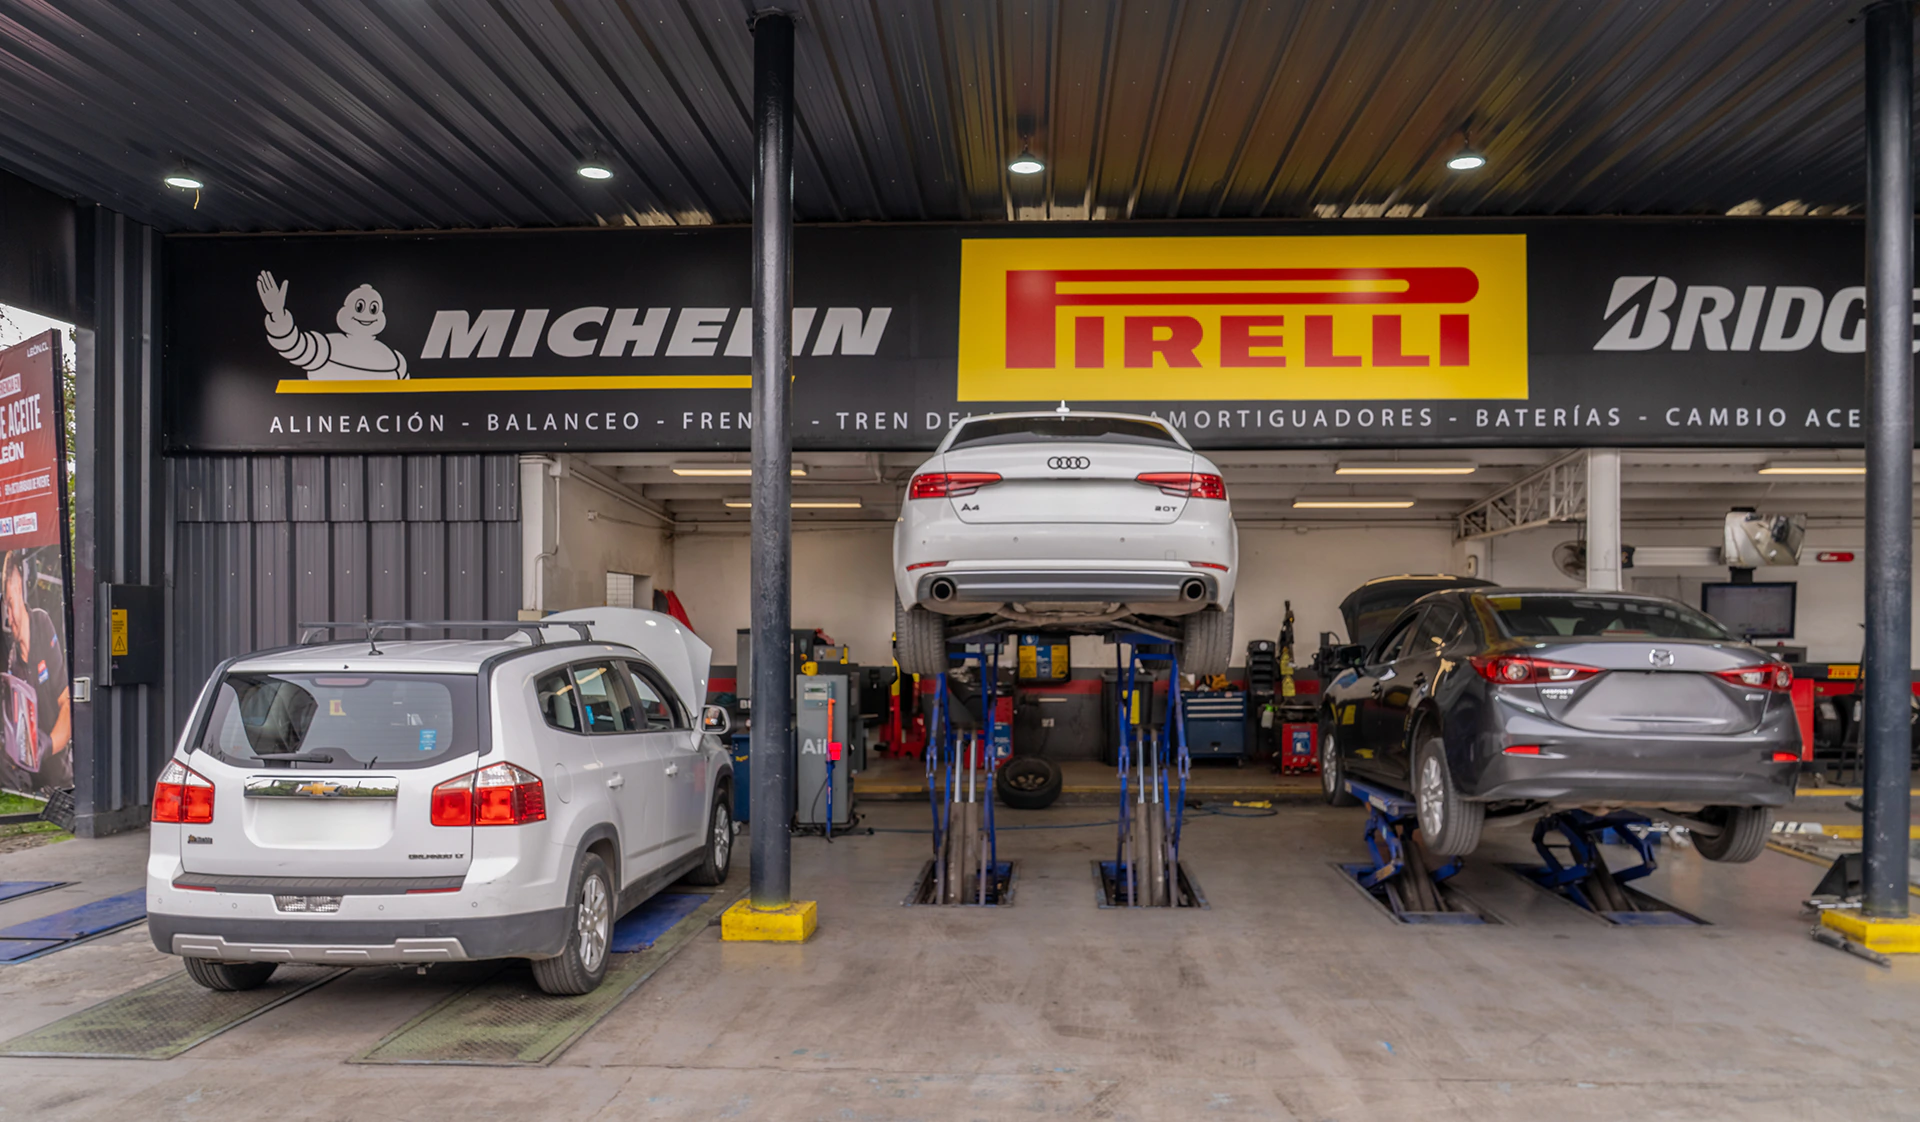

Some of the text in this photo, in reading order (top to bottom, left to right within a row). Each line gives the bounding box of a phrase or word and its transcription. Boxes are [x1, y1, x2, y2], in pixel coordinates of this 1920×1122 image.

[421, 306, 892, 358] MICHELIN
[1005, 267, 1479, 369] PIRELLI
[1593, 275, 1920, 353] BRIDG
[8, 393, 42, 438] ACEITE
[269, 411, 444, 433] ALINEACIÓN
[487, 412, 639, 431] BALANCEO
[683, 411, 753, 430] FREN
[836, 411, 908, 430] TREN
[1476, 403, 1620, 427] BATERÍAS
[1665, 407, 1786, 427] CAMBIO
[1804, 408, 1861, 428] ACE
[961, 503, 980, 512] A4
